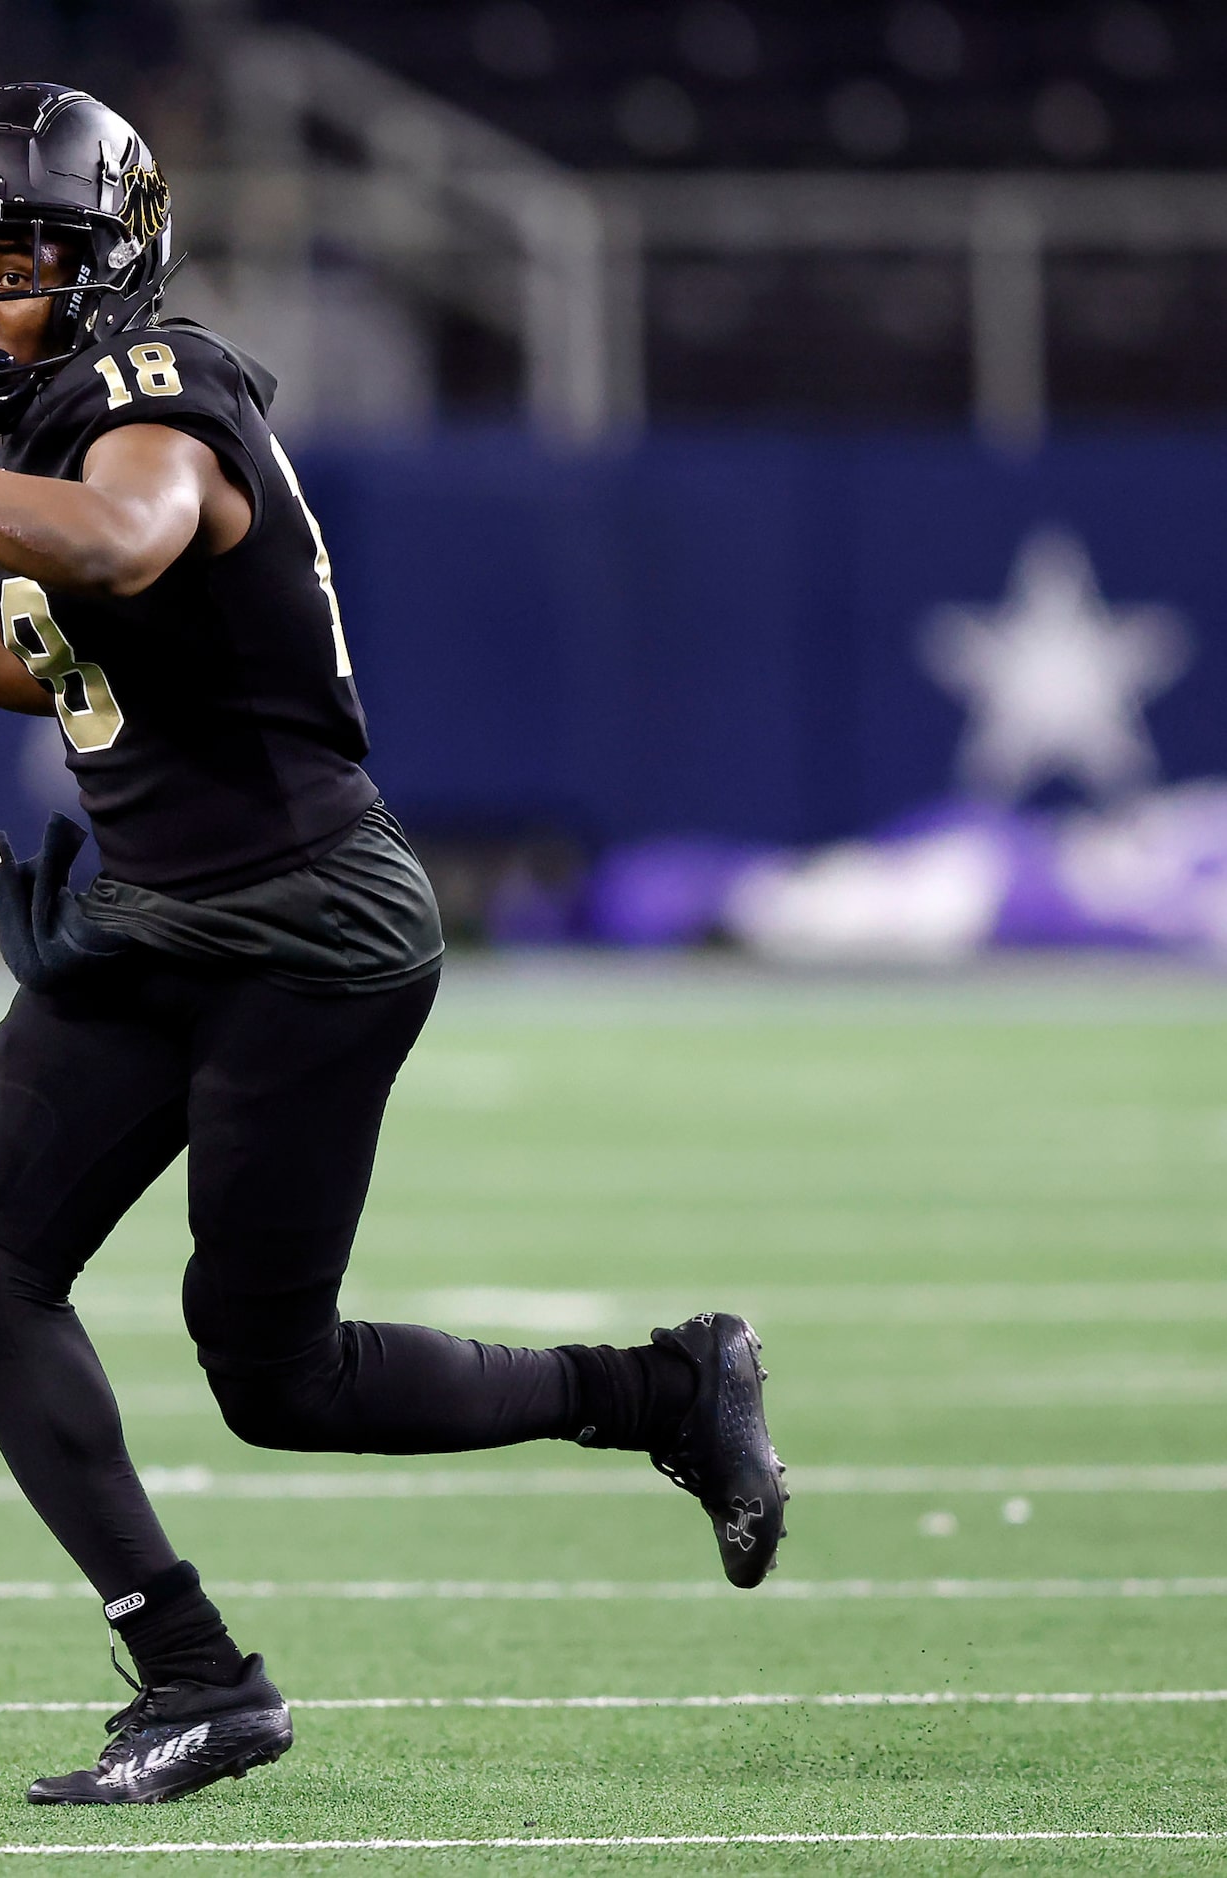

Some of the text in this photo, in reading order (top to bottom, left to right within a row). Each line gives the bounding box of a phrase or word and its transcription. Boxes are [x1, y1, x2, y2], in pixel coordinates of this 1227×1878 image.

[66, 264, 91, 319] SCUTT
[93, 342, 184, 411] 18
[0, 576, 124, 754] 8
[107, 1595, 142, 1616] BATTLE
